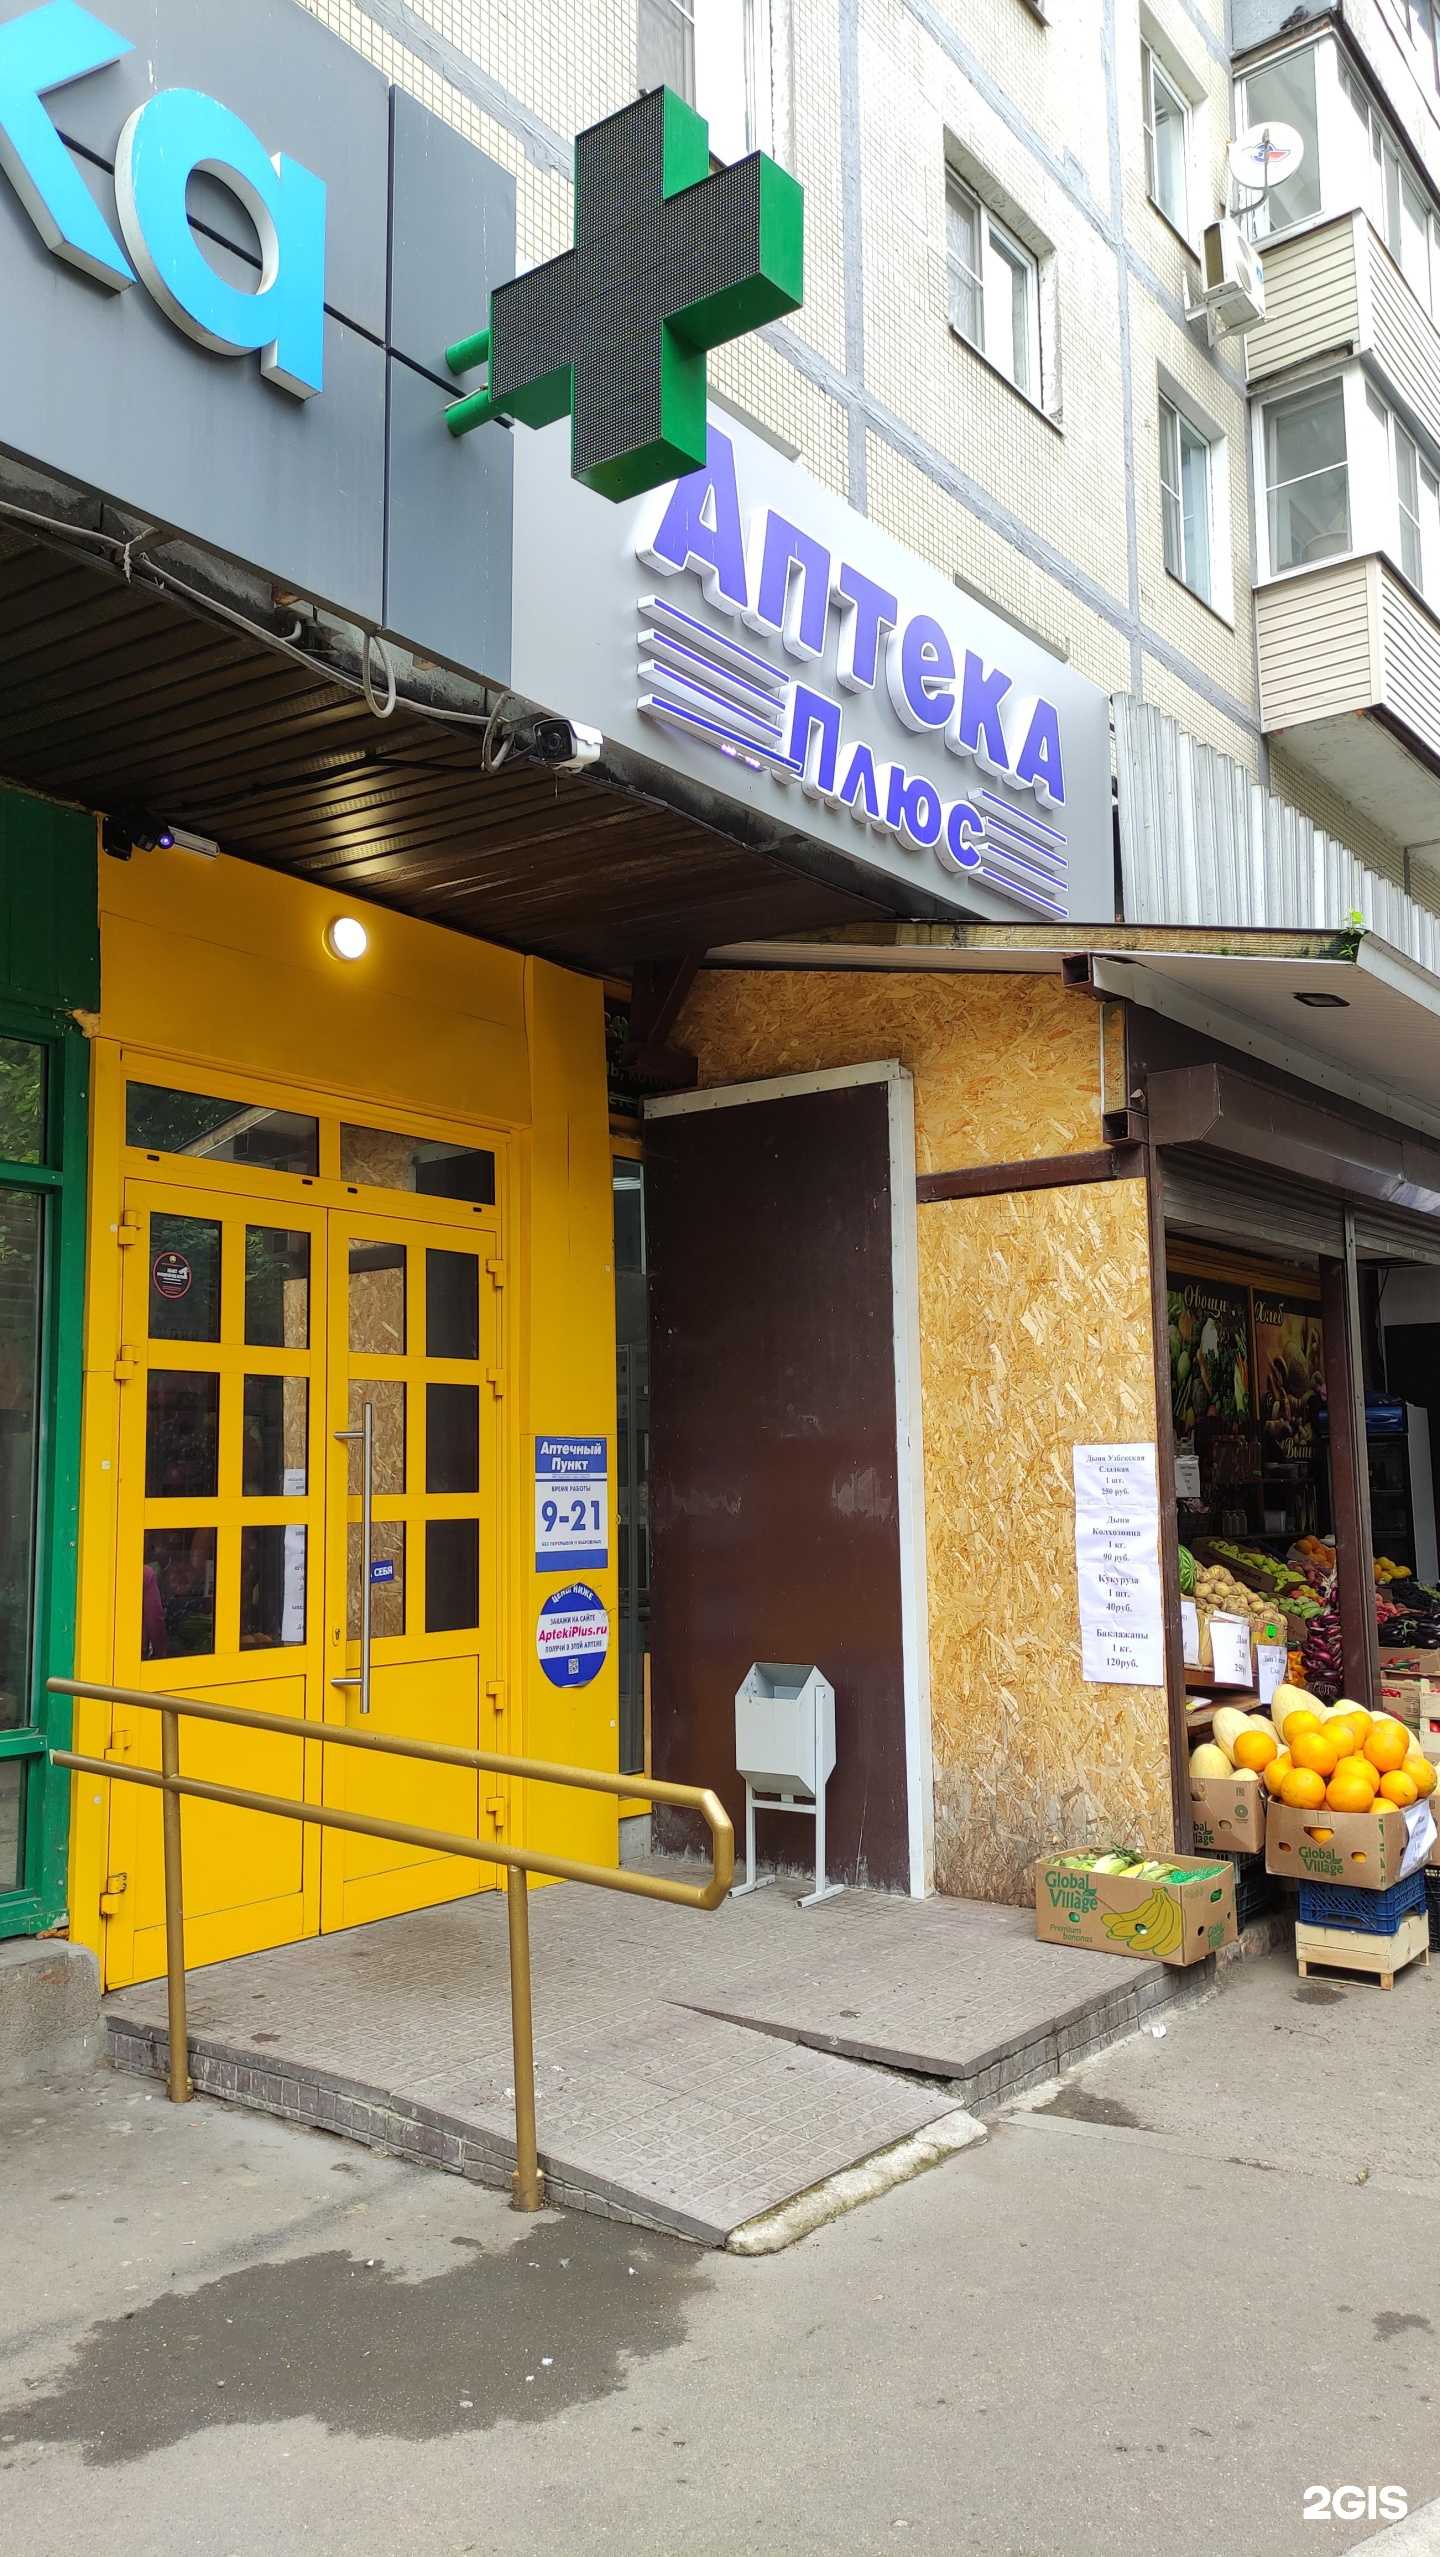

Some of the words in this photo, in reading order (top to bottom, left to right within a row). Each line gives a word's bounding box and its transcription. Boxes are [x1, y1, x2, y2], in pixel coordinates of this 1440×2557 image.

[1184, 1284, 1227, 1319] Овощи
[1254, 1300, 1285, 1325] Хлеб
[540, 1441, 602, 1455] Аптечный
[551, 1456, 589, 1473] Пункт
[541, 1500, 600, 1532] 9-21
[1114, 1553, 1130, 1563] руб.
[1098, 1573, 1139, 1585] Кукуруза
[538, 1625, 608, 1643] AptekiPlus.ru
[1096, 1628, 1149, 1640] Баклажаны
[1106, 1657, 1139, 1669] 120руб.
[1299, 1846, 1336, 1860] Global
[1303, 1858, 1344, 1876] Village
[1045, 1871, 1090, 1890] Global
[1049, 1888, 1098, 1913] Village
[1050, 1923, 1082, 1934] Premium
